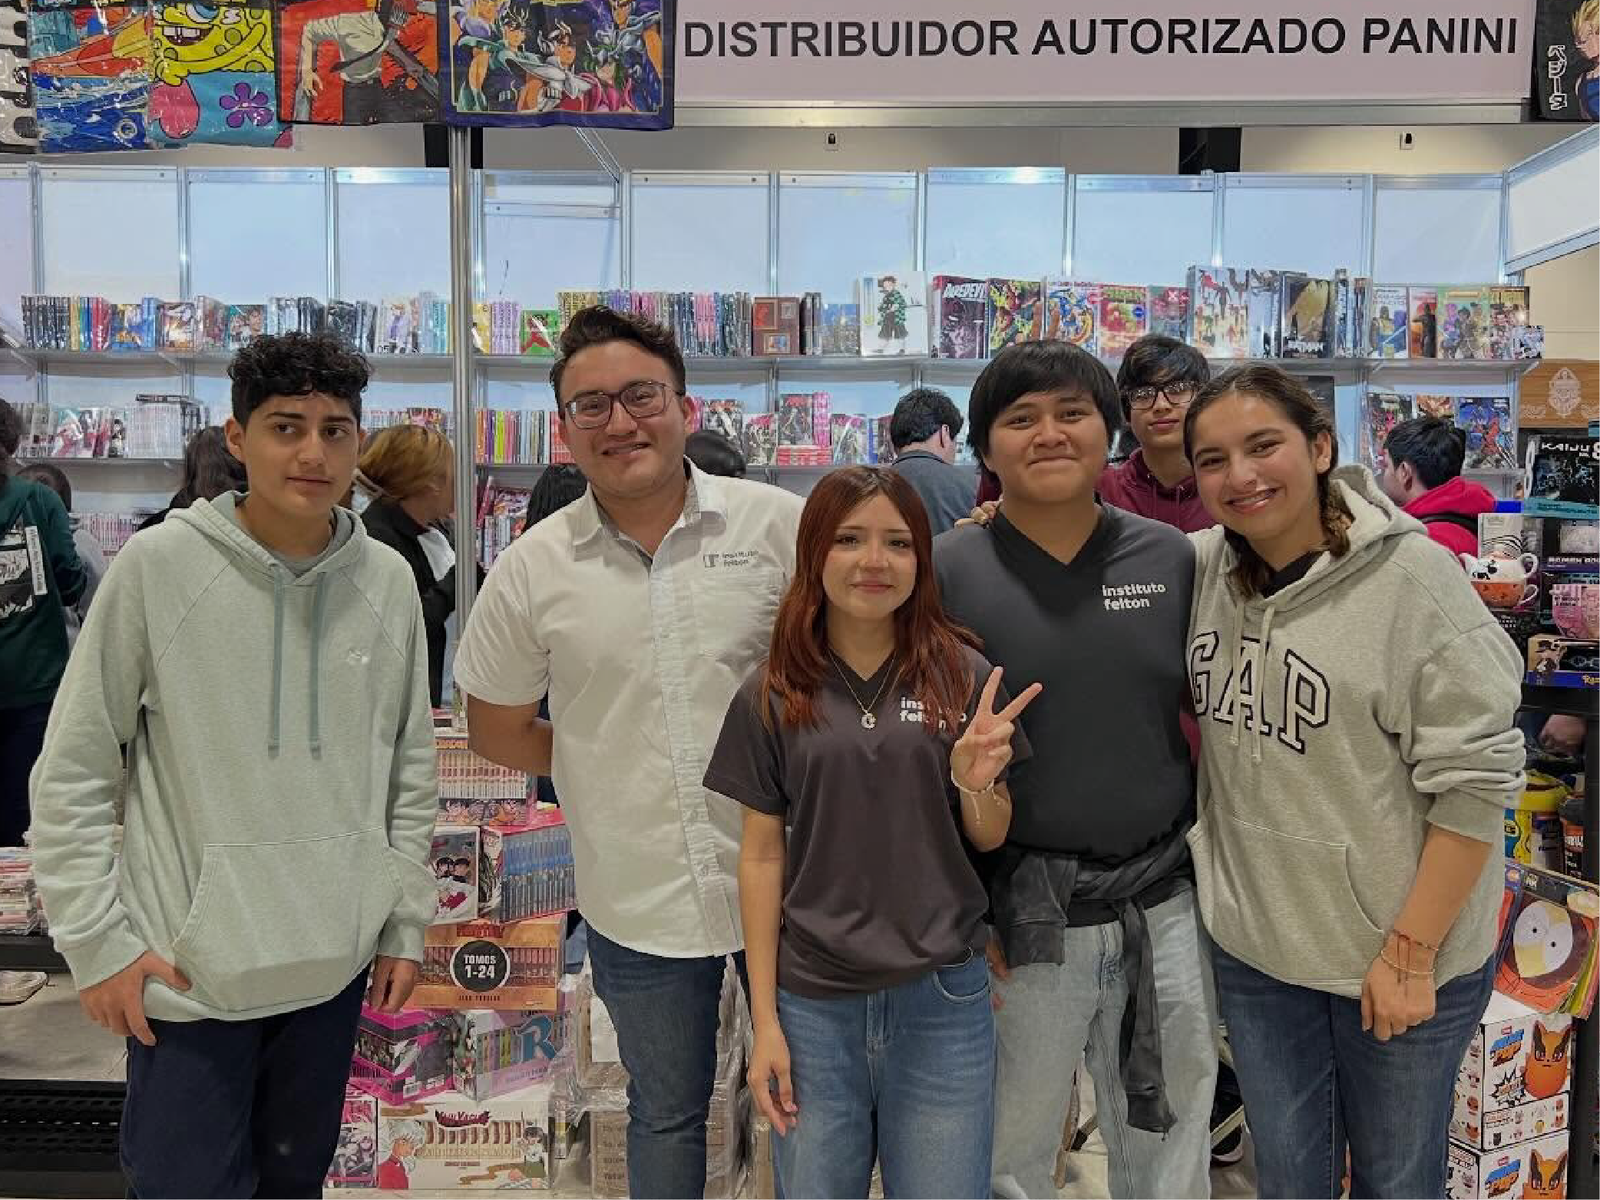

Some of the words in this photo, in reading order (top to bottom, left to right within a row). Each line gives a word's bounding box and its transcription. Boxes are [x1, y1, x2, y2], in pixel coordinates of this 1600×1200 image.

[684, 21, 1020, 58] DISTRIBUIDOR
[1032, 18, 1346, 56] AUTORIZADO
[1363, 17, 1517, 54] PANINI
[1547, 44, 1568, 111] ベジータ
[1102, 583, 1166, 597] instituto
[1104, 597, 1150, 611] felton
[1188, 630, 1331, 755] GAP
[464, 954, 497, 965] TOMOS
[465, 965, 496, 979] 1-24
